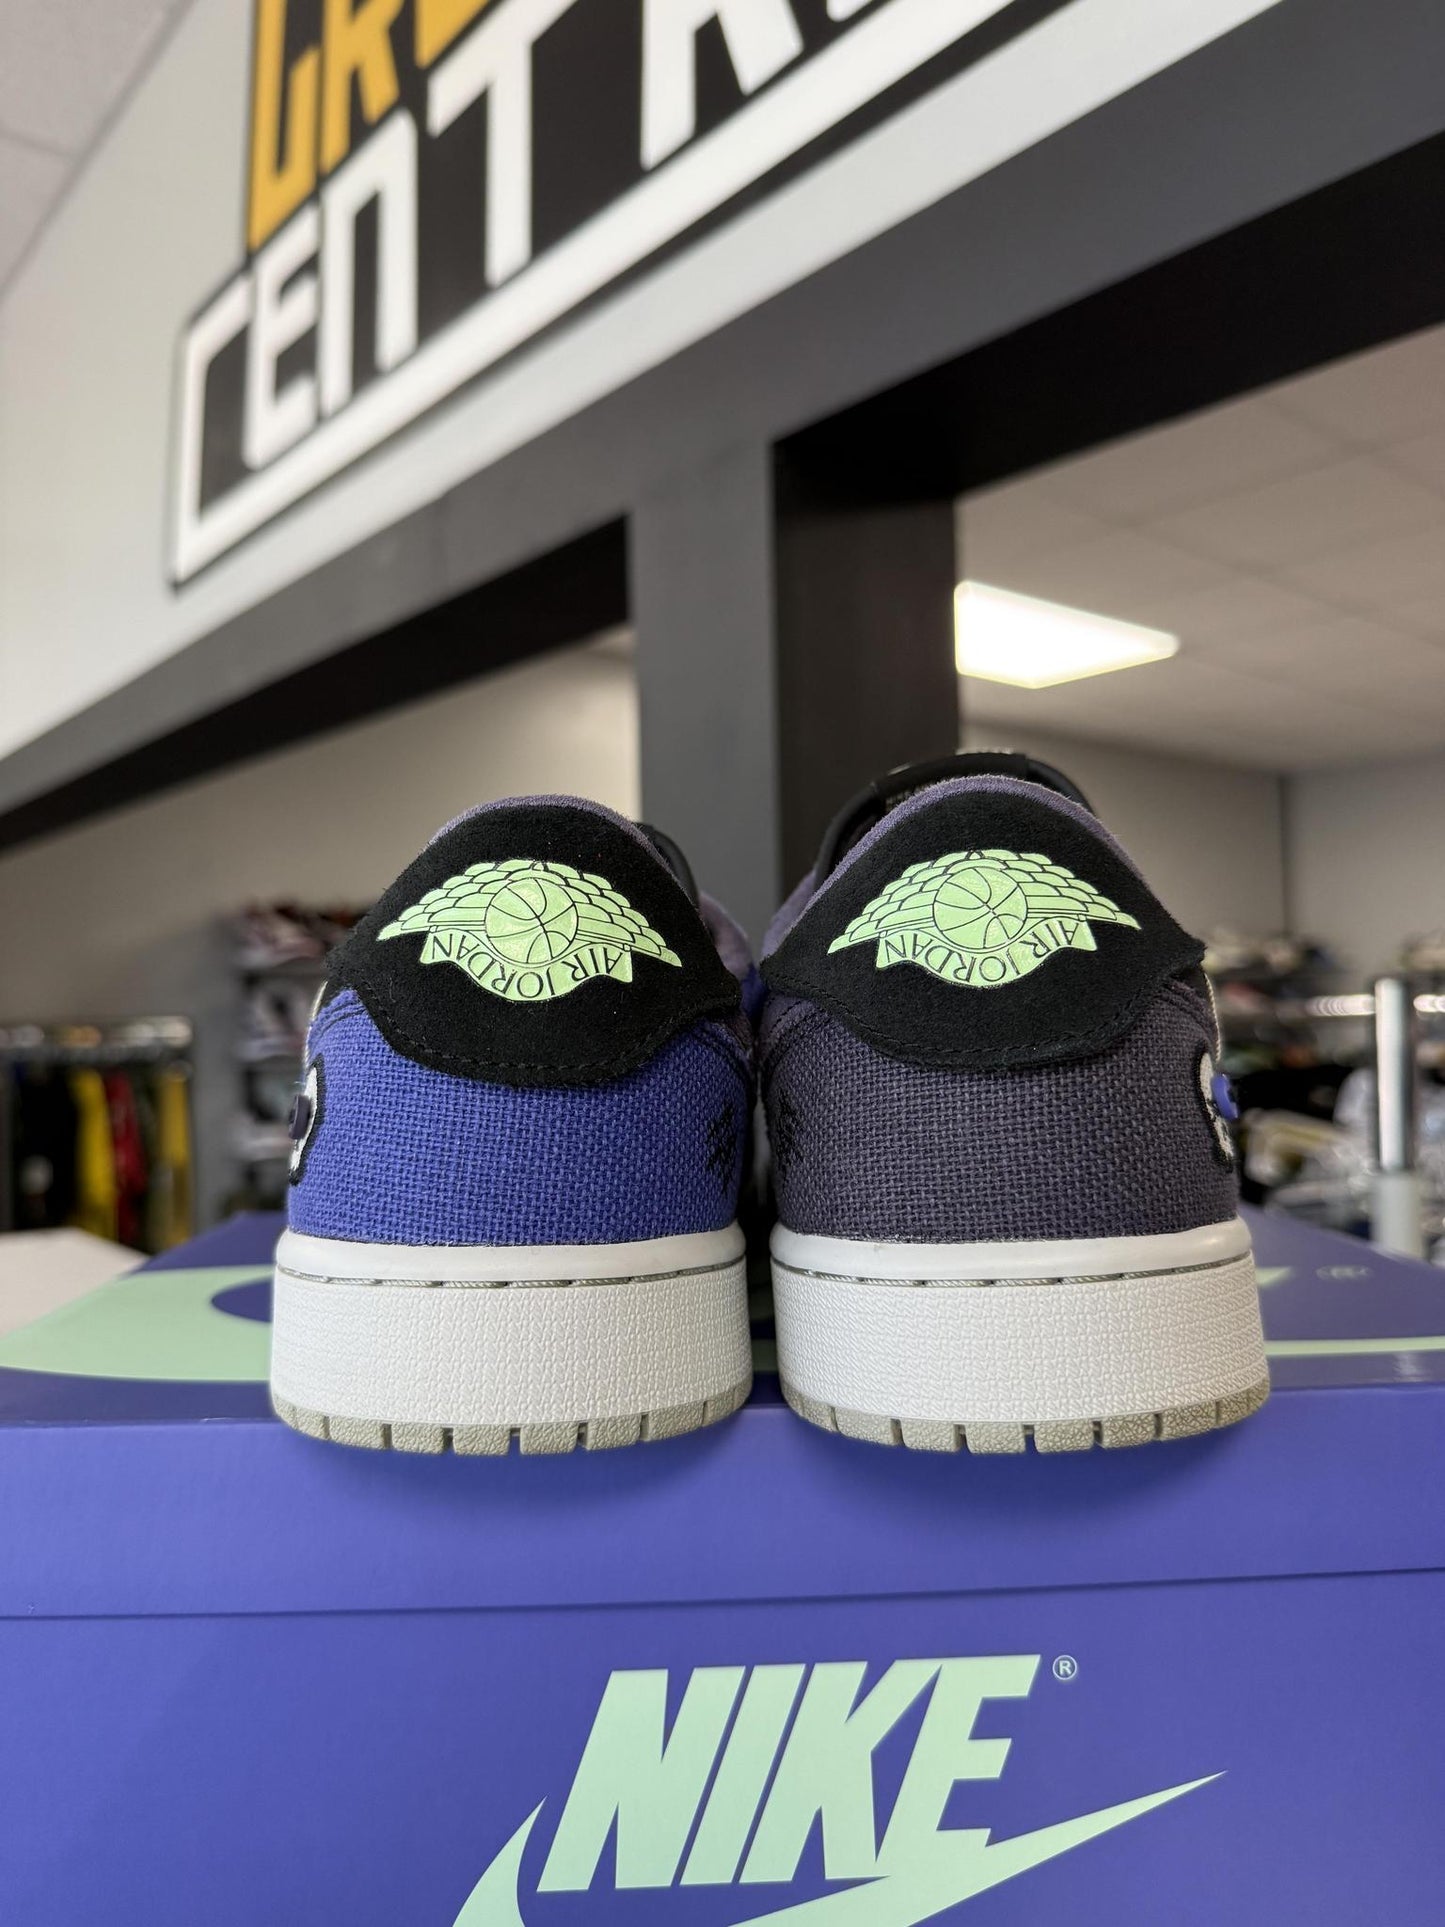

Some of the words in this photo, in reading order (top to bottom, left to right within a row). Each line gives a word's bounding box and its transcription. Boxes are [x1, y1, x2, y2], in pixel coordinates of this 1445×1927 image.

[431, 933, 556, 999] JORDAN
[562, 946, 627, 983] AIR
[885, 932, 1021, 984] JORDAN
[1021, 921, 1080, 960] AIR
[536, 1654, 1041, 1893] NIKE
